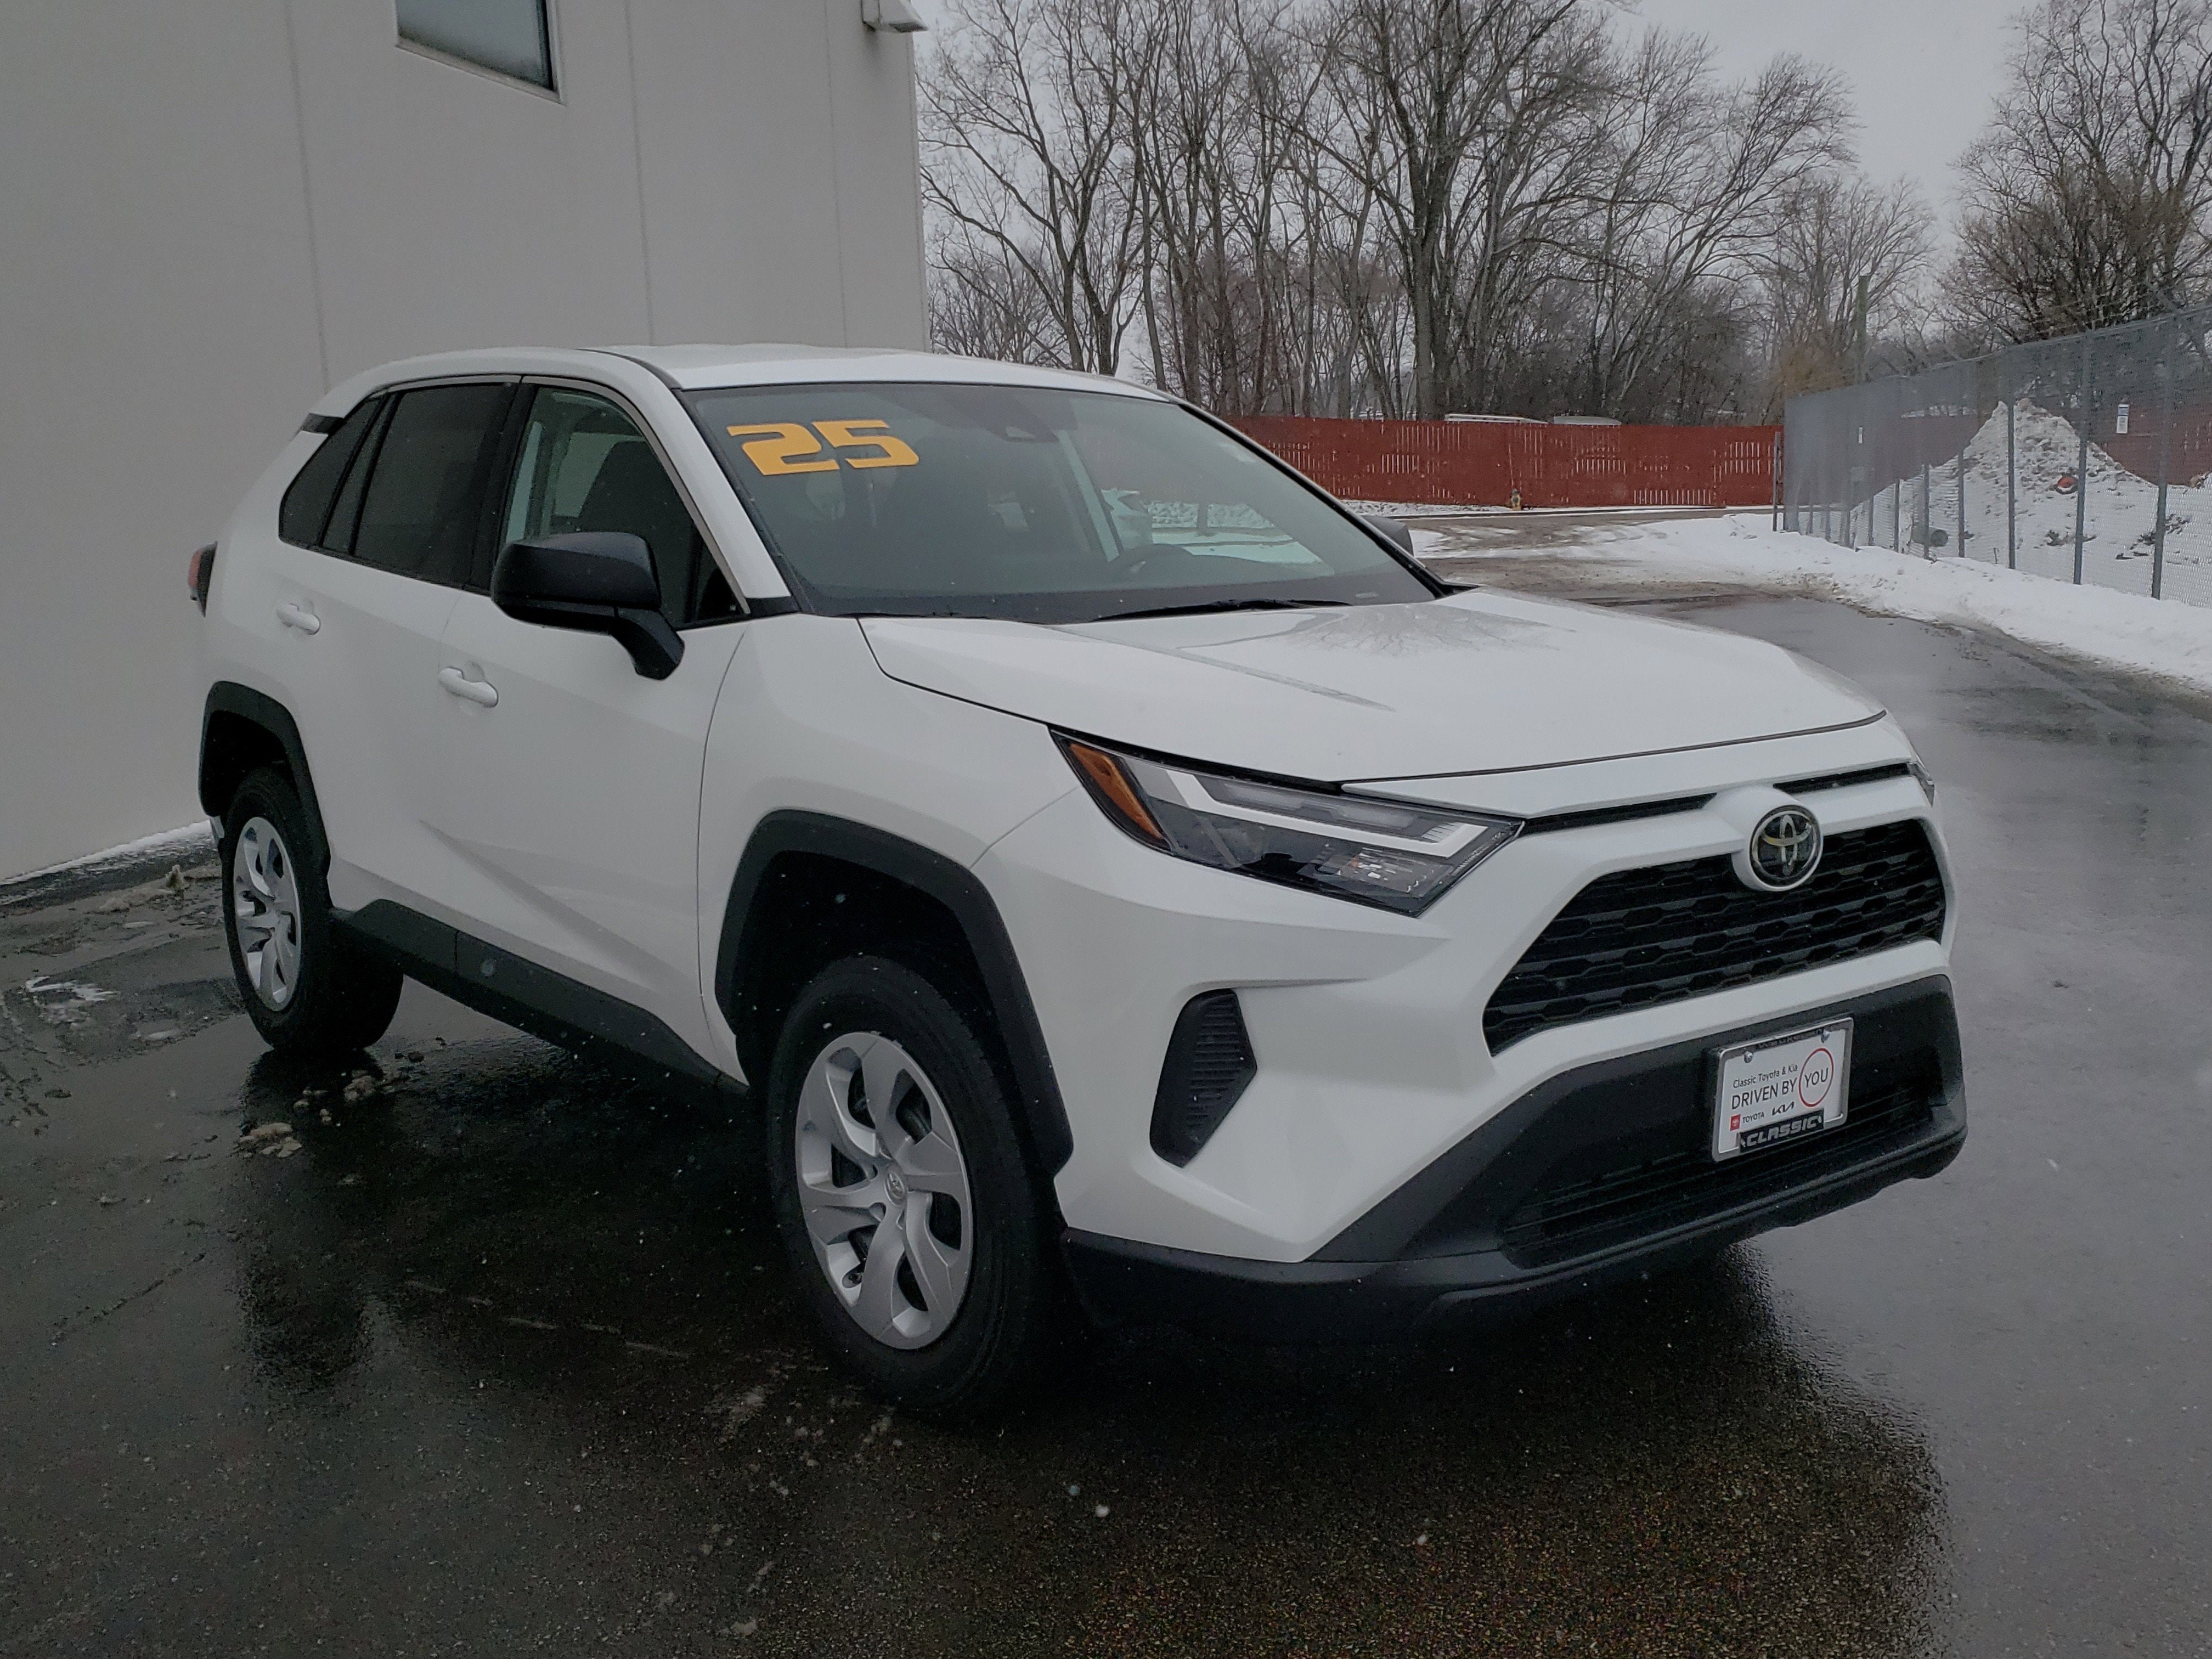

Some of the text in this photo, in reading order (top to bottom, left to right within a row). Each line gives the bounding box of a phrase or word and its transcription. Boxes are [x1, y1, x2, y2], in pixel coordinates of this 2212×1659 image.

[726, 419, 919, 476] 25
[1732, 1067, 1829, 1110] DRIVEN BY YOU
[1733, 1064, 1798, 1088] Classic Toyota & Kia
[1742, 1111, 1764, 1124] TOYOTA
[1747, 1115, 1819, 1147] CLASSIC
